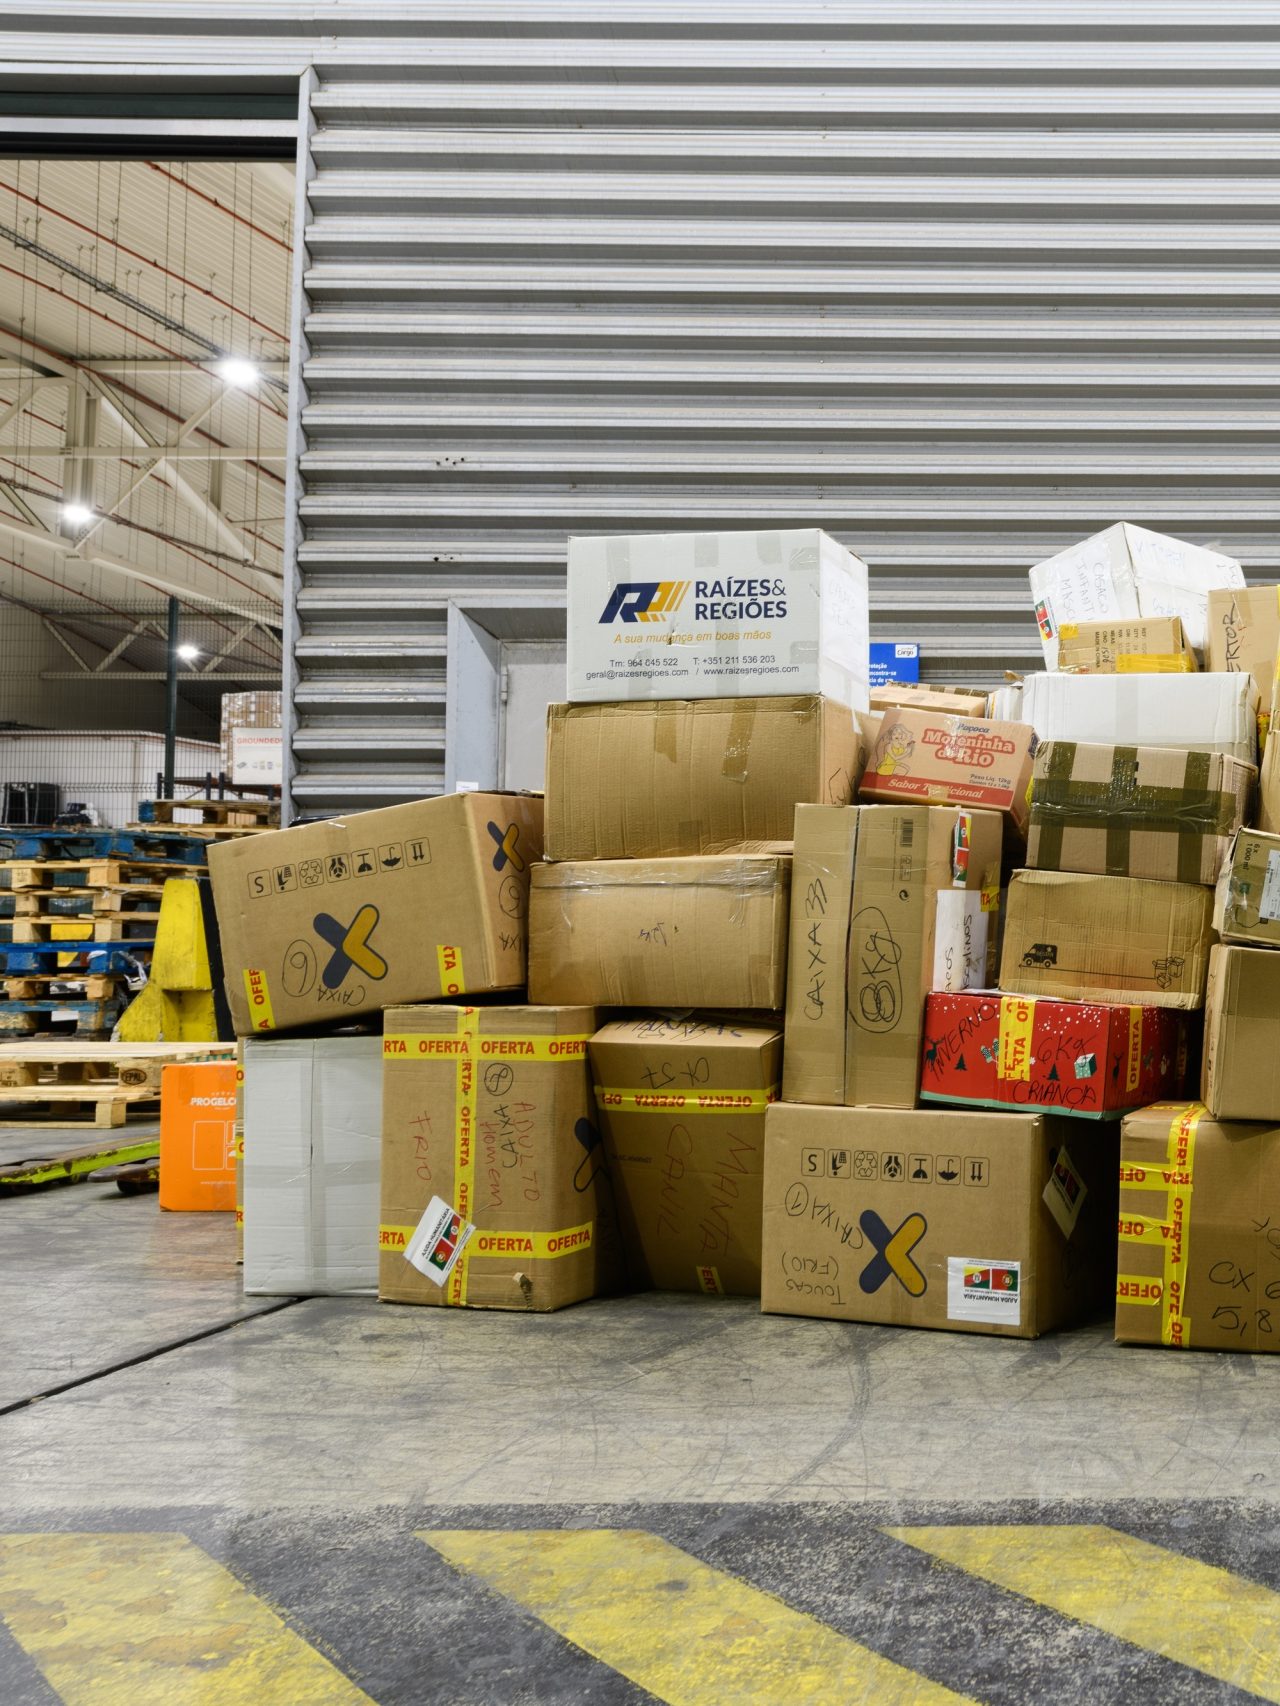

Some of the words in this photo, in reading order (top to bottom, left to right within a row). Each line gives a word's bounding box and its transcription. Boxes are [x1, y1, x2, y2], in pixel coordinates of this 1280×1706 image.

[1076, 555, 1096, 622] INFANT
[695, 599, 787, 620] REGIÕES
[614, 634, 622, 644] A
[624, 635, 643, 644] sua
[696, 633, 713, 642] em
[715, 631, 740, 641] boas
[743, 629, 772, 640] mãos
[663, 657, 679, 666] 522
[702, 655, 724, 665] +351
[725, 655, 740, 664] 211
[742, 655, 758, 664] 536
[760, 655, 776, 664] 203
[953, 747, 993, 767] Rio
[888, 778, 921, 791] Sabor
[317, 985, 366, 1006] CAIXA
[419, 1041, 469, 1054] OFERTA
[481, 1041, 535, 1055] OFERTA
[1129, 1019, 1141, 1086] OFERTA
[1012, 1081, 1097, 1113] CRIANÇA
[408, 1110, 433, 1183] FRIO
[459, 1105, 471, 1168] OFERTA
[700, 1131, 757, 1253] MANTA
[478, 1237, 533, 1252] OFERTA
[548, 1230, 592, 1252] OFERTA
[785, 1279, 846, 1306] TOUCAS
[1117, 1281, 1162, 1299] OFER
